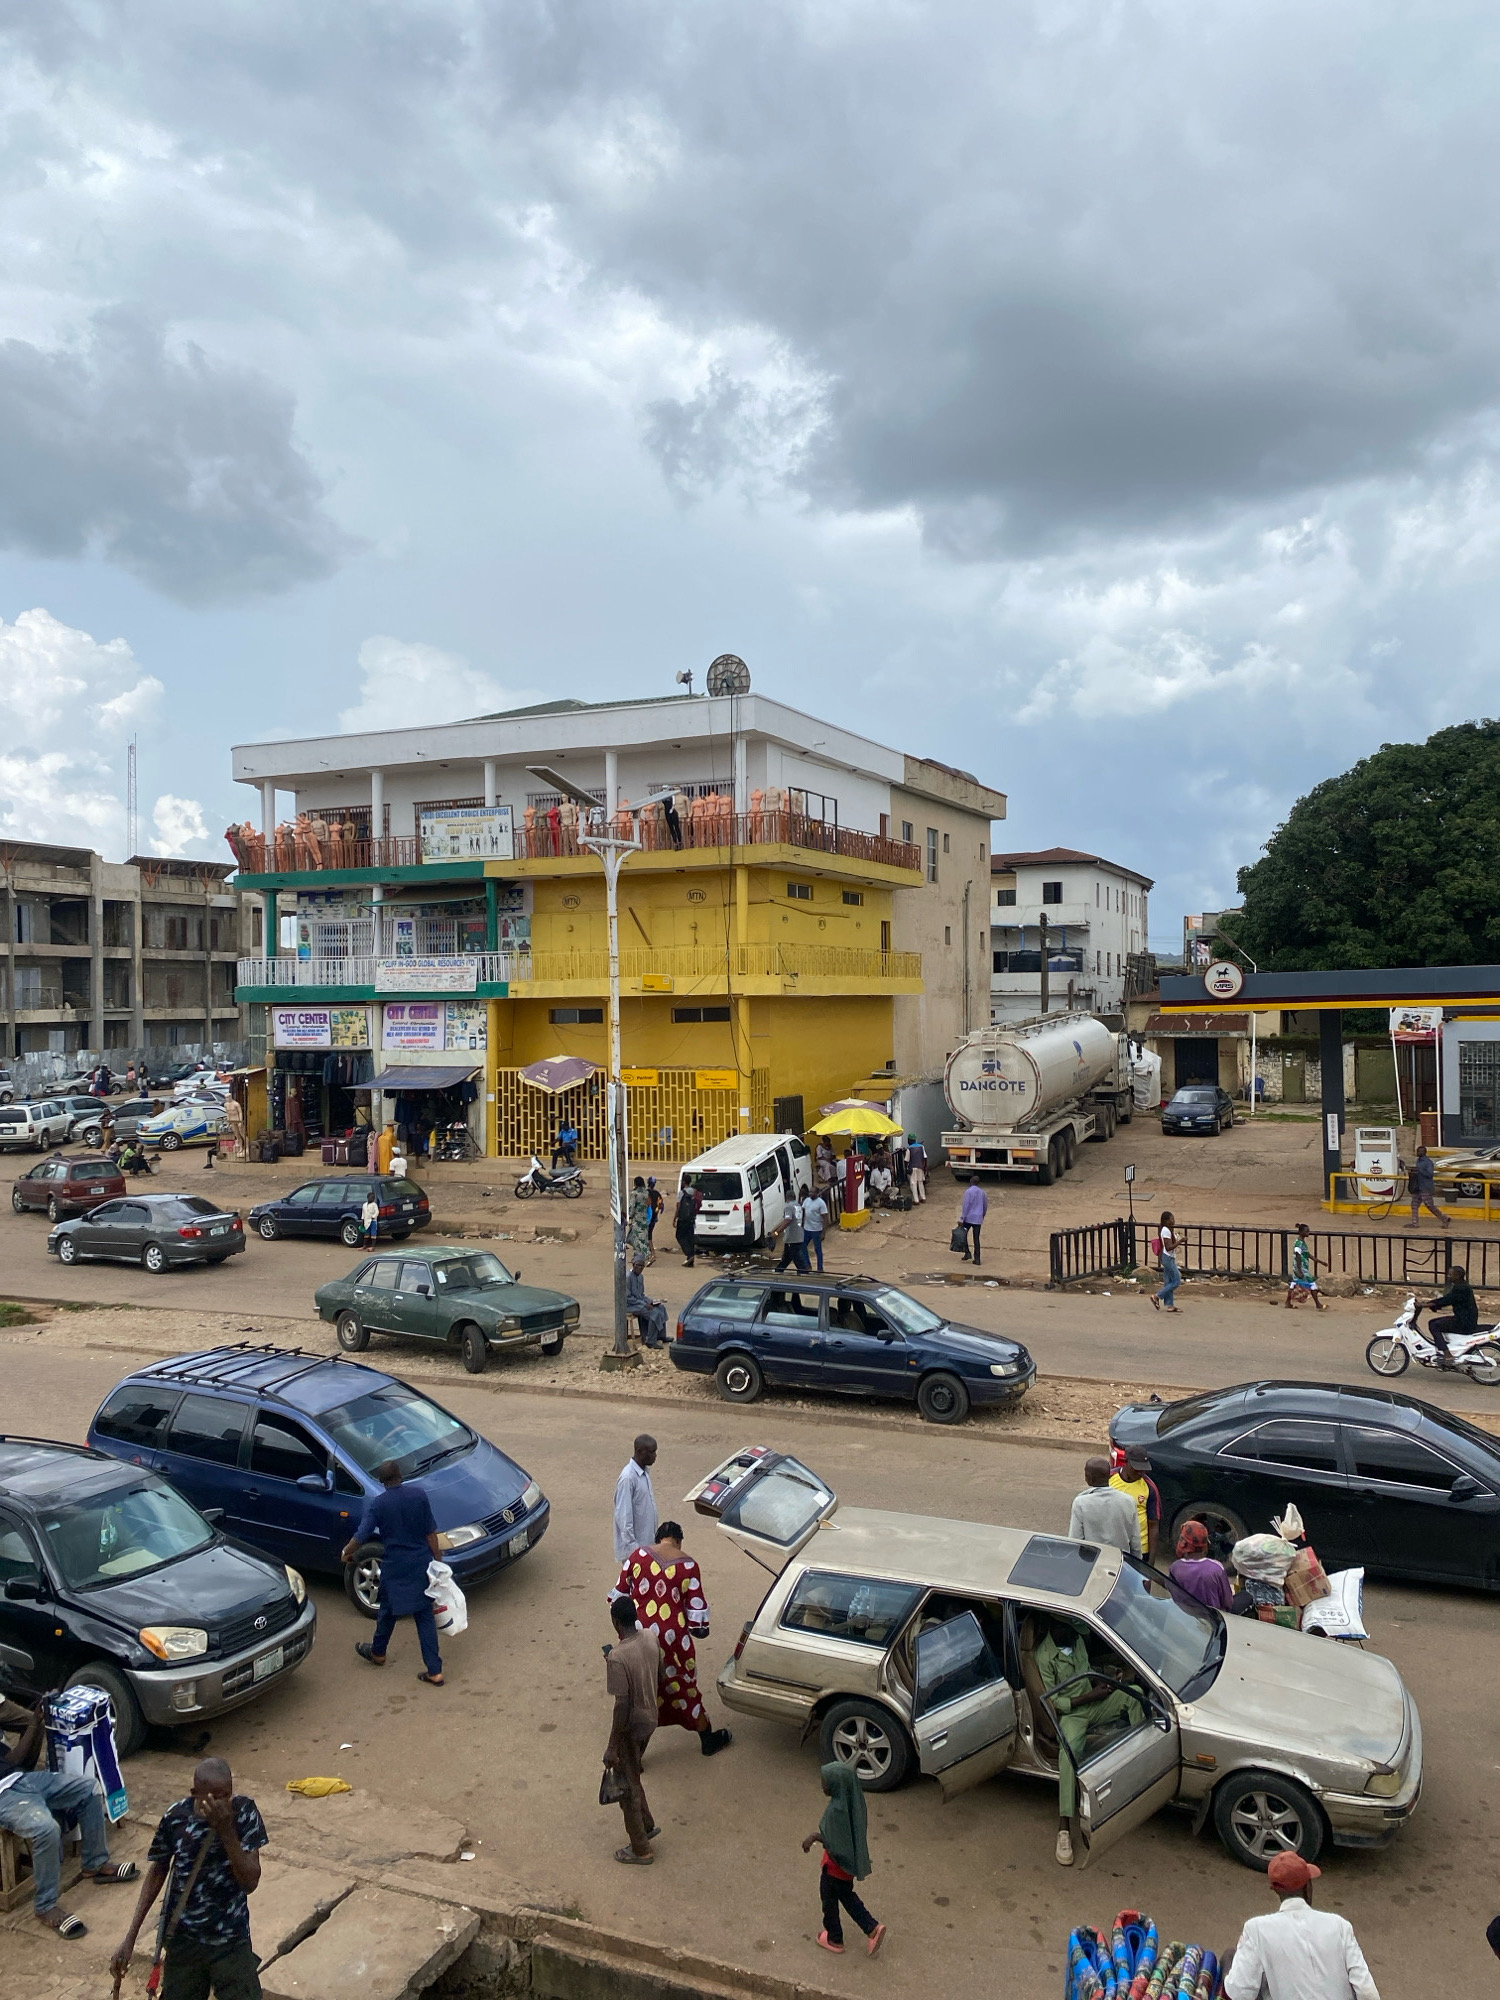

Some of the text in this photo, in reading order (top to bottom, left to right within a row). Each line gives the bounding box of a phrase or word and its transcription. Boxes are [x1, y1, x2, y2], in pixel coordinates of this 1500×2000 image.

[435, 810, 460, 819] EXCELLENT
[460, 809, 479, 818] CHOICE
[480, 808, 509, 817] ENTERPRISE
[464, 825, 484, 834] OPEN
[418, 959, 436, 967] GLOBAL
[437, 959, 465, 967] RESOURCES
[387, 1005, 406, 1020] CITY
[278, 1013, 329, 1025] CITY CENTER
[959, 1080, 1026, 1092] DANGOTE
[854, 1160, 864, 1173] OUT
[1126, 1165, 1134, 1181] OUT
